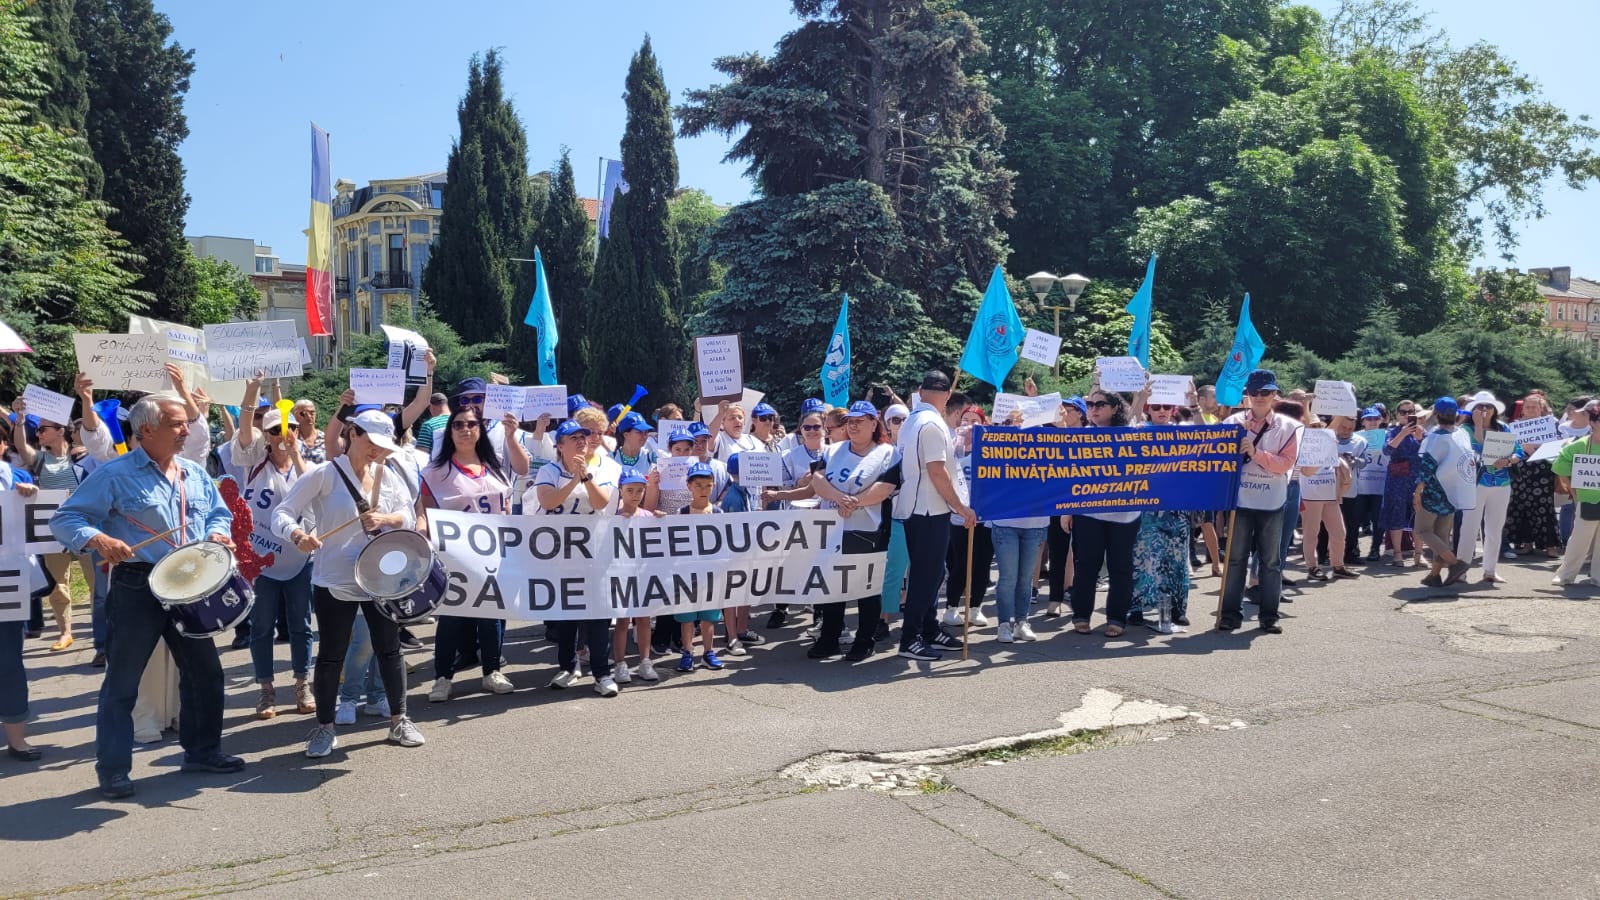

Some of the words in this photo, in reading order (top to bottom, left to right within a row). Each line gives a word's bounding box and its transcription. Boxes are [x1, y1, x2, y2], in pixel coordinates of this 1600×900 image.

[1513, 417, 1550, 430] RESPECT
[981, 432, 1034, 446] FEDERAȚIA
[1037, 433, 1112, 444] SINDICATELOR
[1115, 432, 1153, 442] LIBERE
[1156, 431, 1174, 441] DIN
[981, 446, 1065, 460] SINDICATUL
[1068, 446, 1114, 460] LIBER
[1118, 446, 1138, 458] AL
[1141, 442, 1238, 458] SALARIAȚILOR
[977, 466, 1001, 478] DIN
[1005, 463, 1122, 483] ÎNVĂȚĂMÂNTUL
[1125, 460, 1237, 476] PREUNIVERSITAR
[1071, 479, 1150, 496] CONSTANȚA
[1239, 481, 1270, 493] NSTANȚA
[1055, 498, 1160, 510] www.constanta.sinv.ro
[249, 532, 283, 555] STANTA
[436, 520, 593, 561] POPOR
[613, 519, 843, 560] NEEDUCAT,
[527, 577, 586, 612] DE
